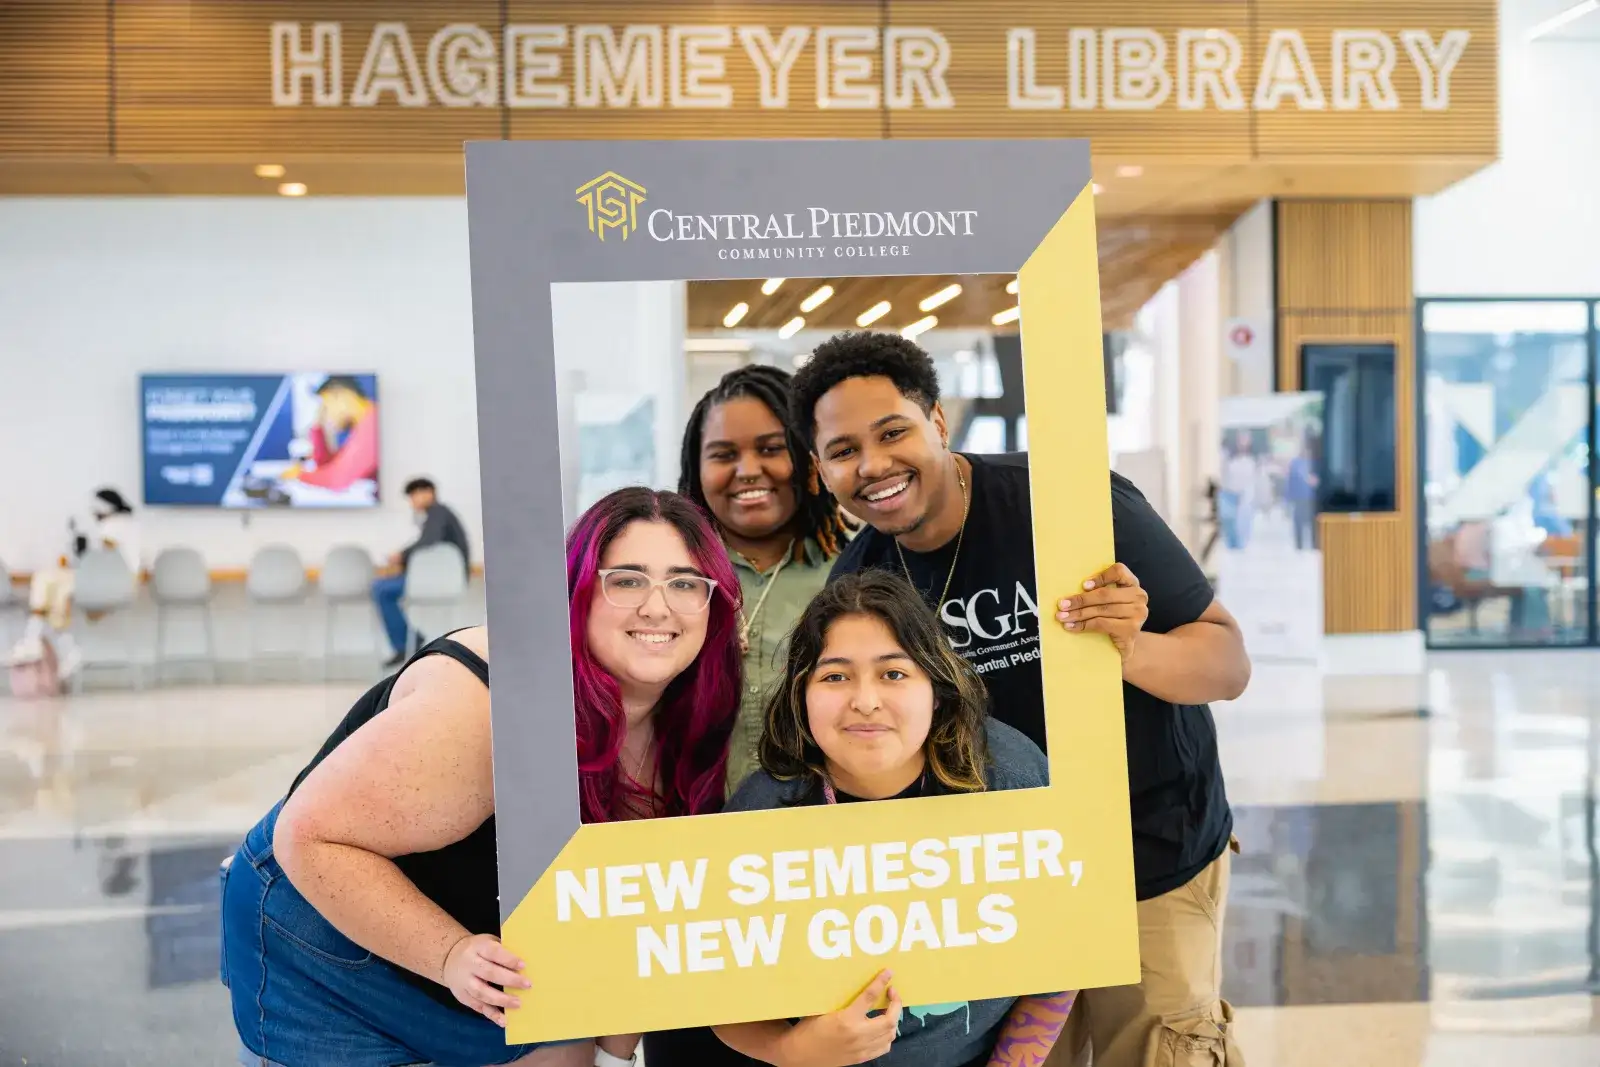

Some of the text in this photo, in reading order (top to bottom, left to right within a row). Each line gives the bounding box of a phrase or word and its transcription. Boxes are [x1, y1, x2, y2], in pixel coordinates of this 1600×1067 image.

[271, 23, 1471, 111] HAGEMEYER LIBRARY
[647, 207, 978, 242] CENTRAL PIEDMONT
[718, 245, 911, 260] COMMUNITY COLLEGE
[940, 580, 1039, 650] SGA
[556, 828, 1083, 921] NEW SEMESTER,
[635, 893, 1018, 978] NEW GOALS
